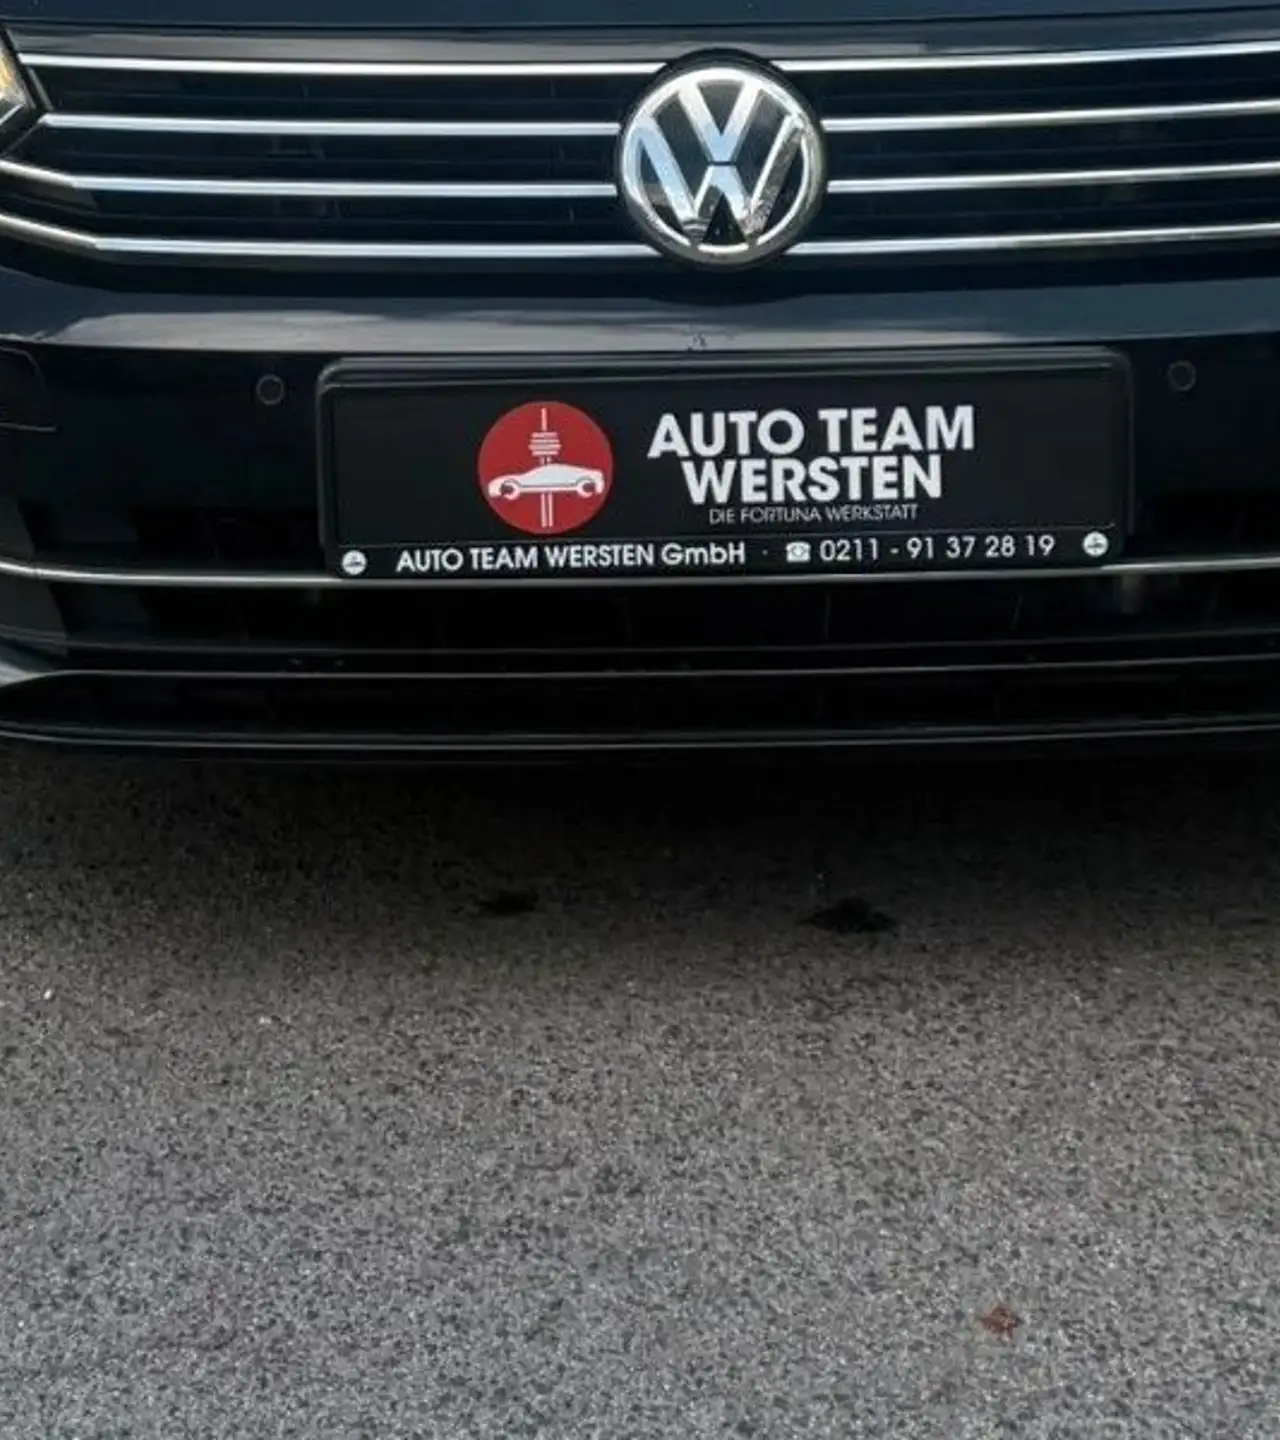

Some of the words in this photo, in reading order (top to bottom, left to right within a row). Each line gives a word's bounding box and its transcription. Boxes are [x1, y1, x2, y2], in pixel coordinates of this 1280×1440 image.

[625, 72, 818, 252] VW
[647, 409, 806, 459] AUTO
[818, 405, 975, 453] TEAM
[681, 454, 943, 505] WERSTEN
[709, 507, 735, 525] DIE
[740, 505, 821, 523] FORTUNA
[824, 503, 919, 522] WERKSTATT
[395, 548, 464, 573] AUTO
[470, 546, 538, 571] TEAM
[545, 543, 655, 569] WERSTEN
[661, 542, 747, 566] GmbH
[820, 538, 879, 561] 0211
[906, 537, 934, 559] 91
[946, 536, 976, 558] 37
[985, 535, 1016, 557] 28
[1026, 534, 1055, 556] 19
